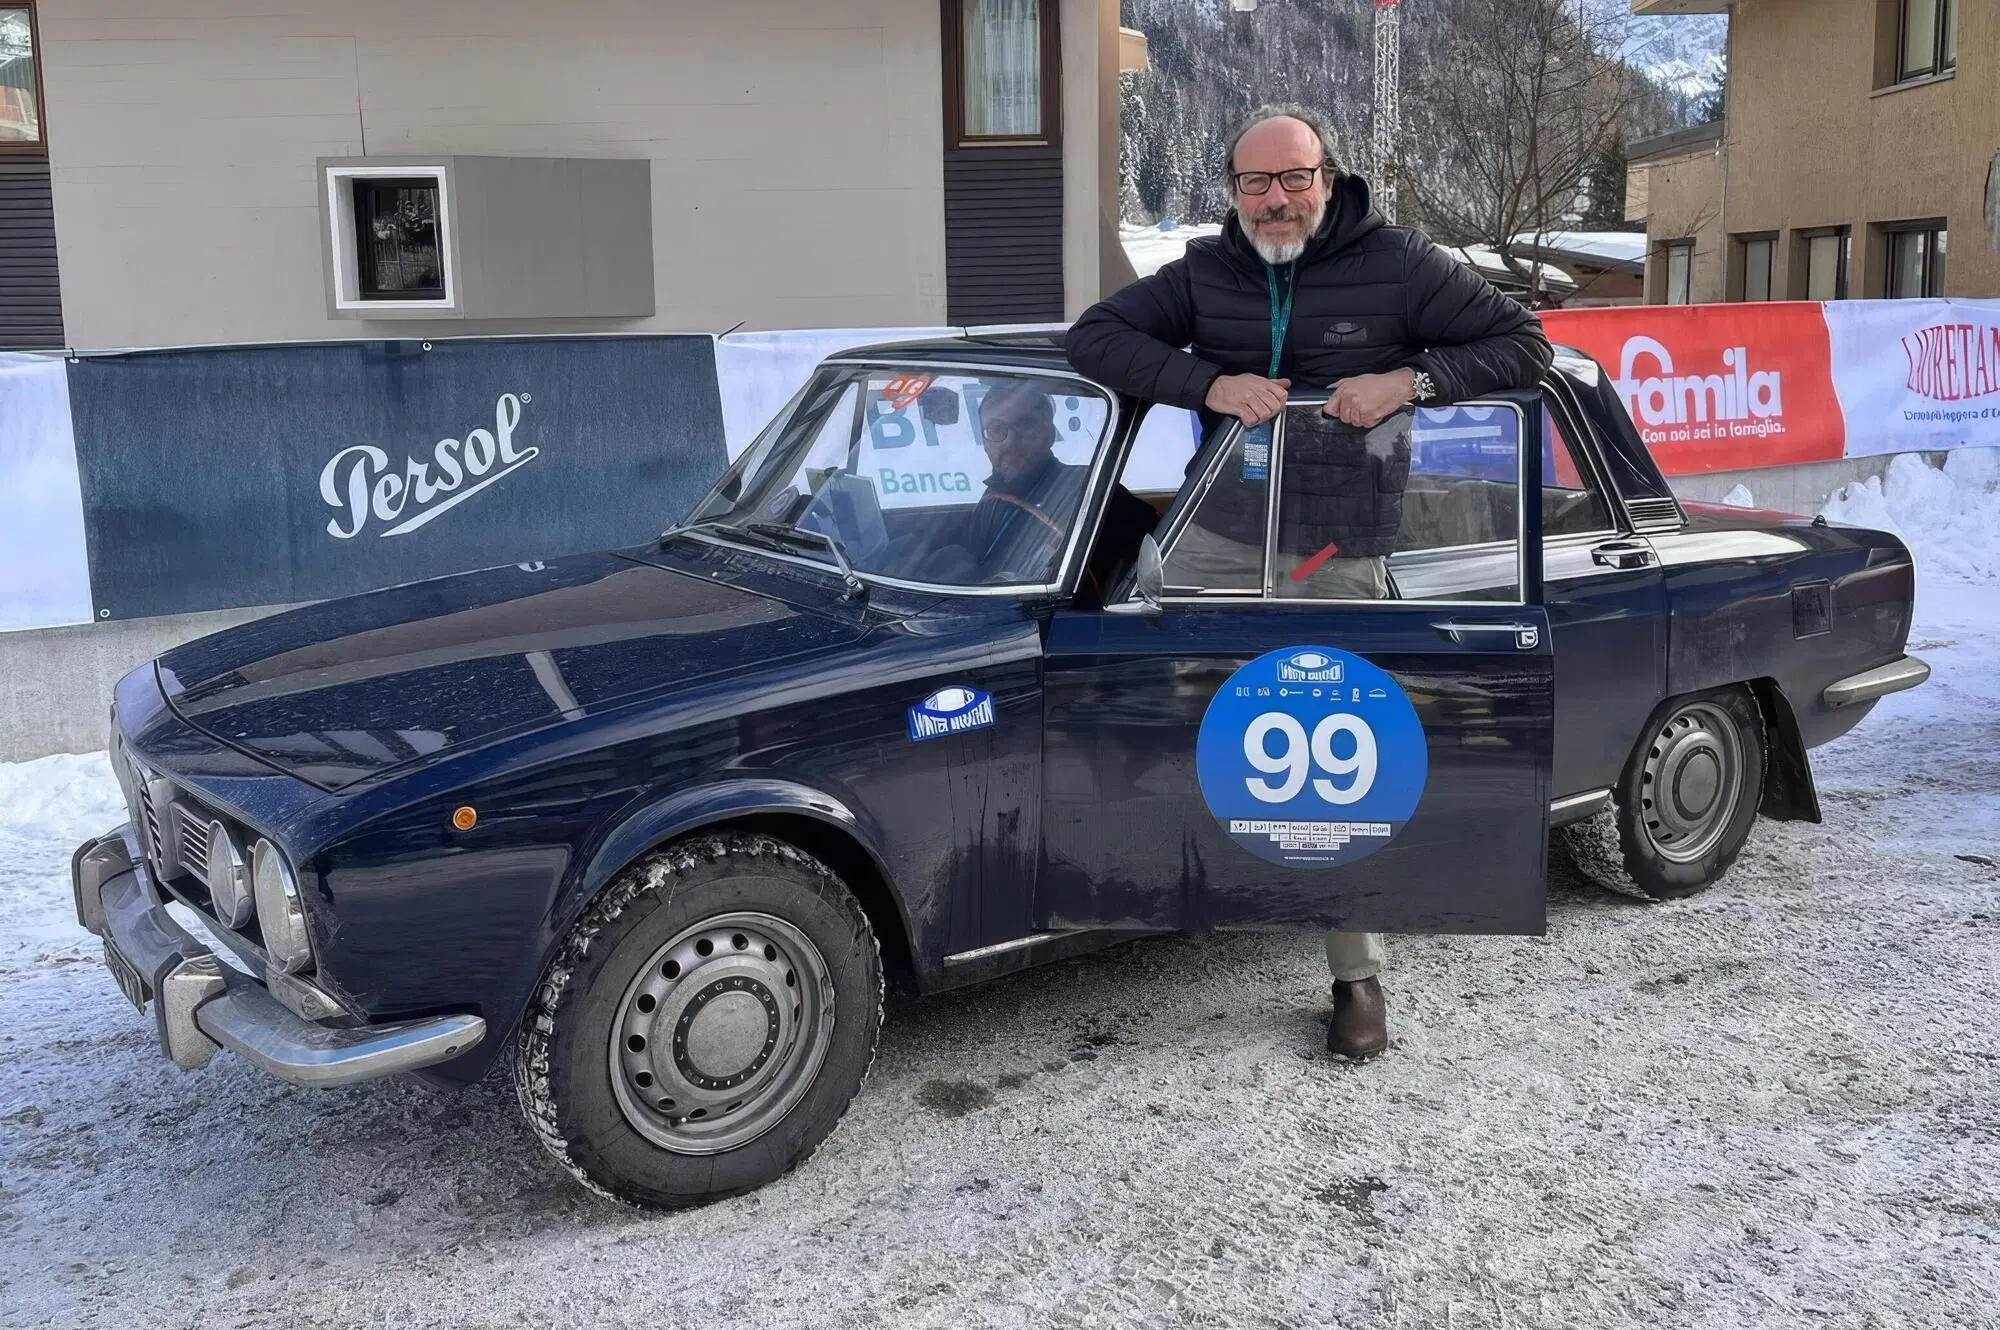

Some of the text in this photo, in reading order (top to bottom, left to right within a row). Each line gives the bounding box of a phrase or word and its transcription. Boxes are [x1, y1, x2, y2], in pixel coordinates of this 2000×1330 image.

[1613, 335, 1784, 425] famila
[318, 391, 539, 539] Persol
[1642, 428, 1667, 443] Con
[1670, 425, 1690, 441] noi
[1715, 423, 1726, 438] in
[879, 467, 971, 495] Banca
[1243, 711, 1378, 805] 99
